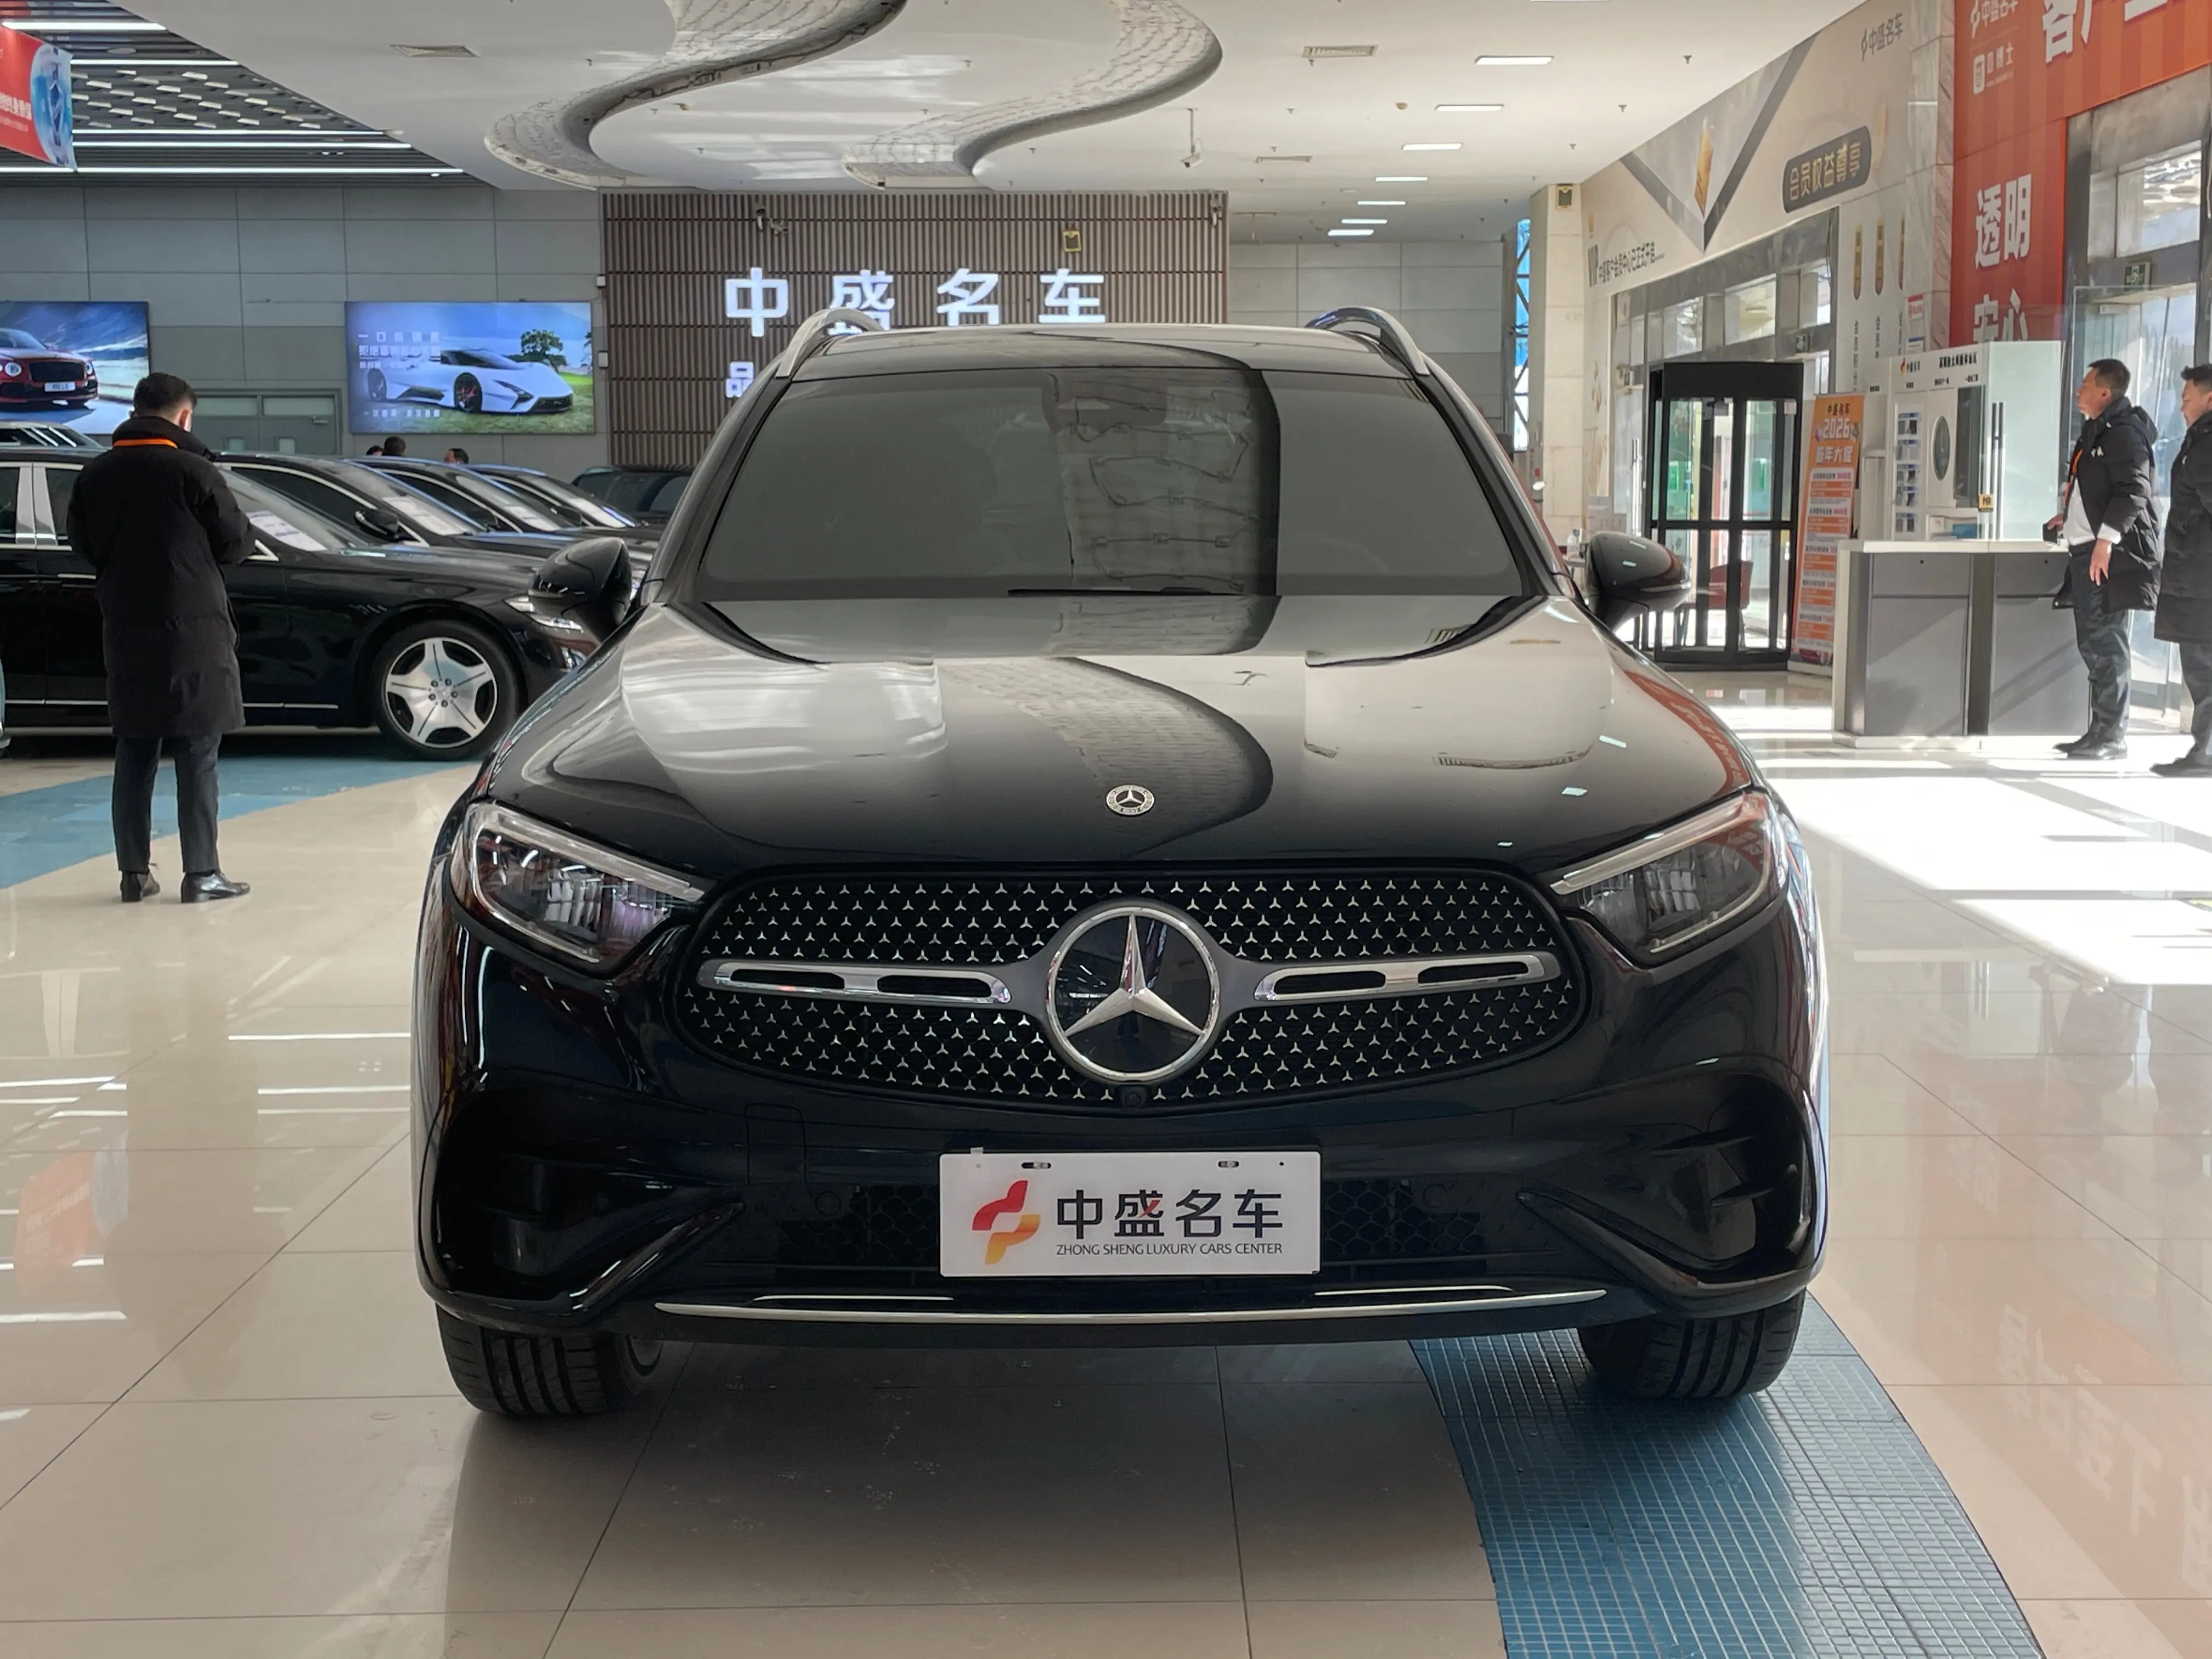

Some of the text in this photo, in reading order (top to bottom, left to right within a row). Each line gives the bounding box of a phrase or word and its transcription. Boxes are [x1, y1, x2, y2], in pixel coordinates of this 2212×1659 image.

[1975, 174, 2032, 269] 透明
[725, 267, 1106, 337] 中盛名车
[1822, 418, 1850, 439] 2026
[1057, 1189, 1283, 1240] 中盛名车
[1057, 1243, 1283, 1256] ZHONG SHENG LUXURY CARS CENTER
